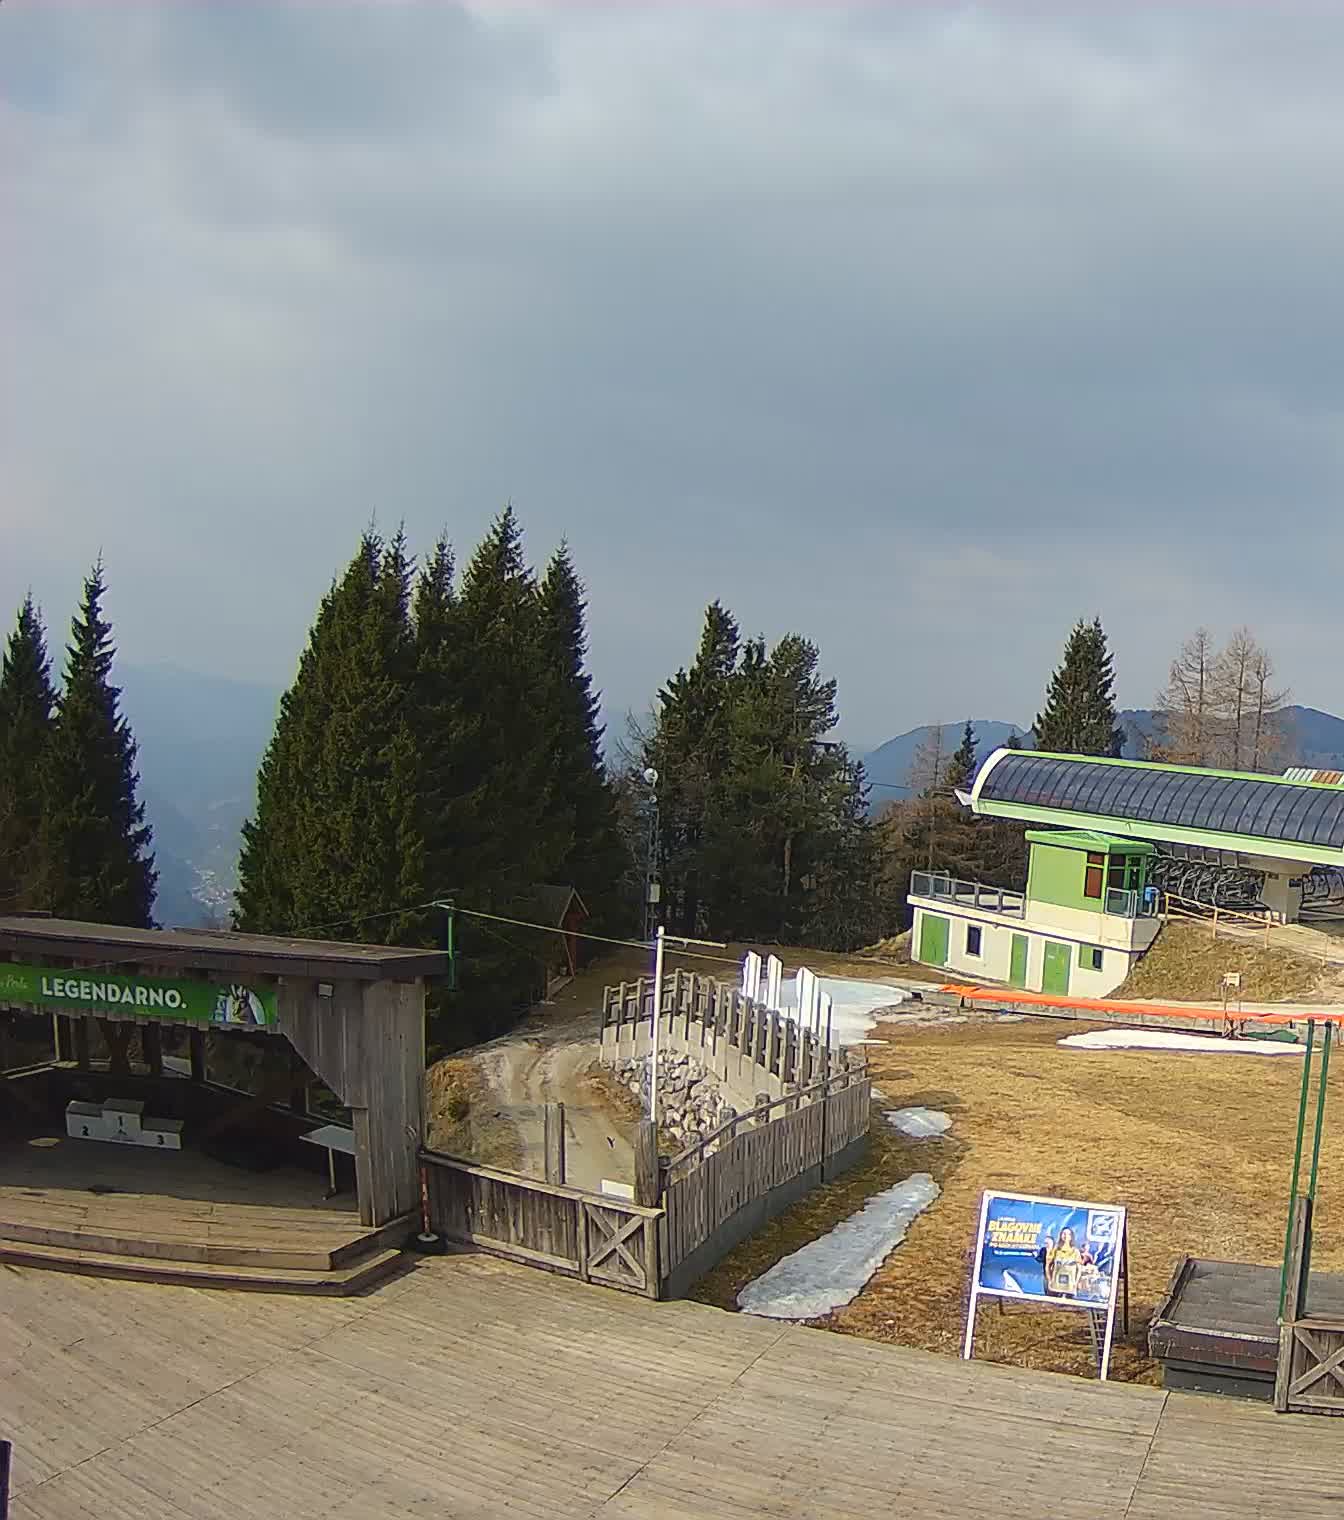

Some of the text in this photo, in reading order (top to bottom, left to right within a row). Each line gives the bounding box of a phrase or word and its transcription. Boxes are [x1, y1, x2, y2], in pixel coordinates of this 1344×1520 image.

[41, 976, 188, 1009] LEGENDARNO.
[82, 1126, 89, 1136] 2
[157, 1134, 165, 1145] 3
